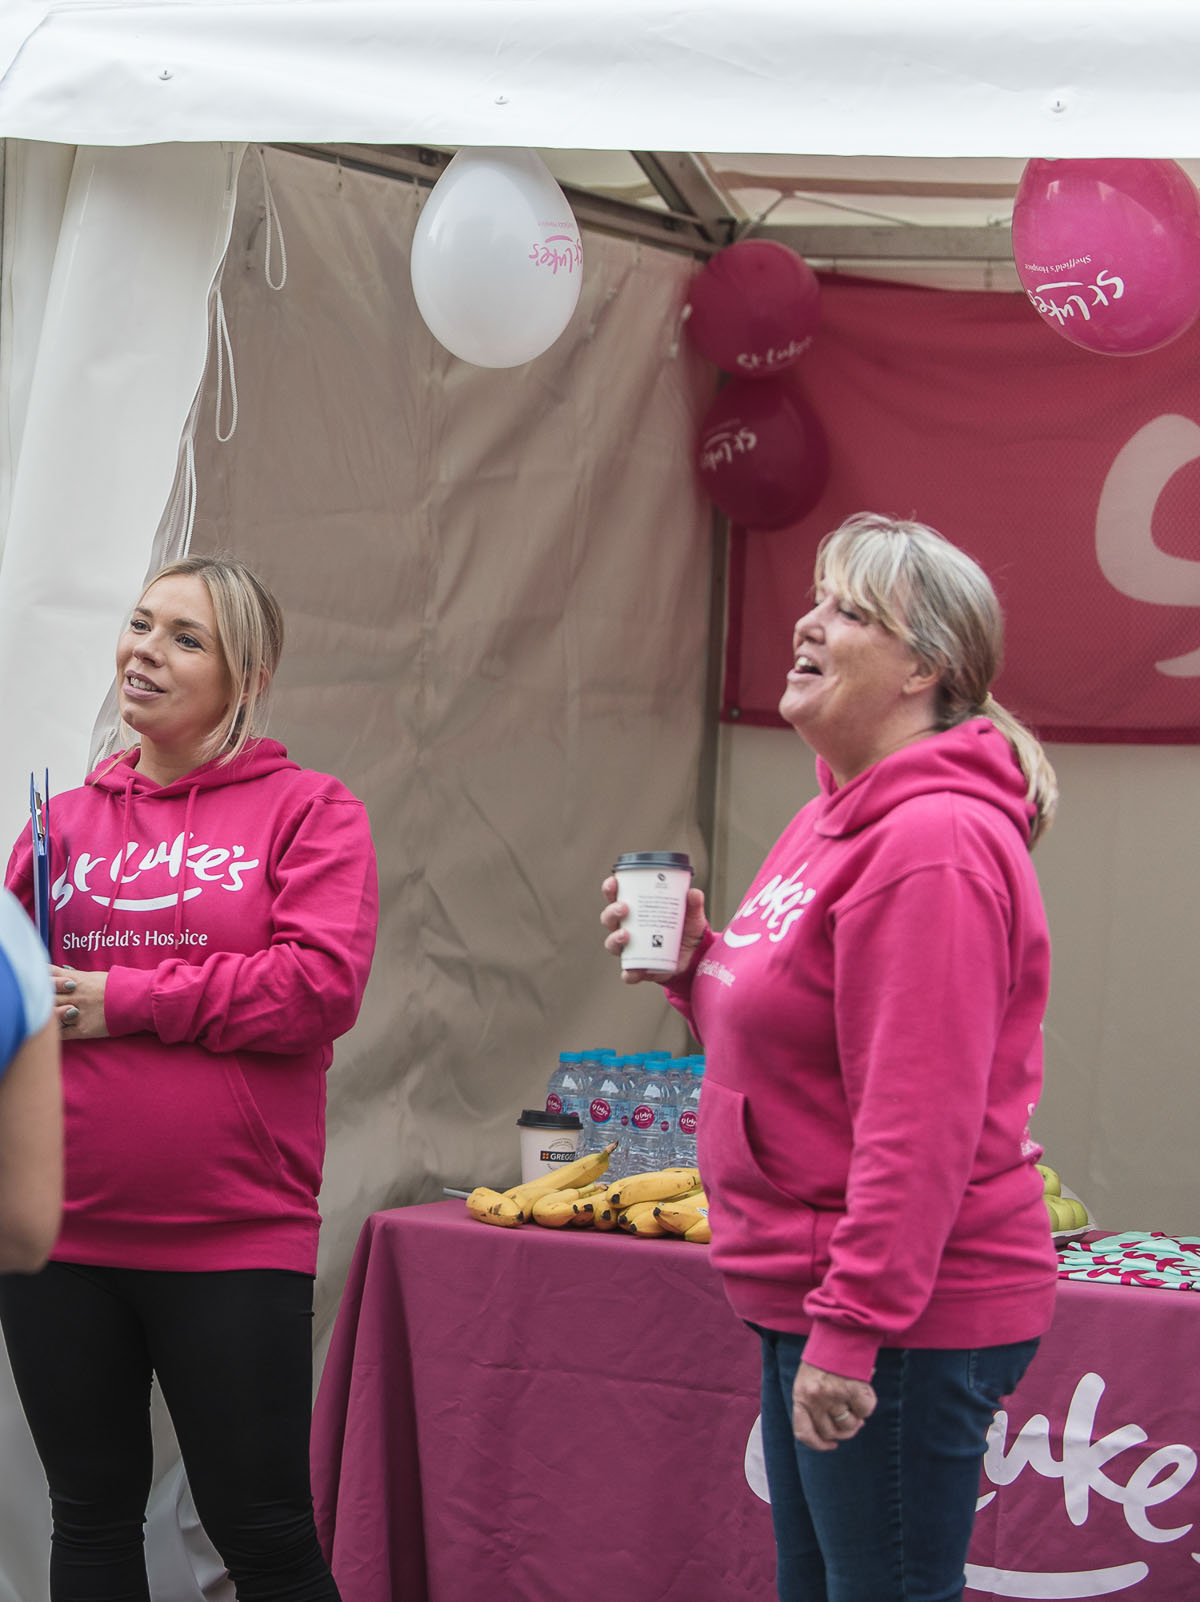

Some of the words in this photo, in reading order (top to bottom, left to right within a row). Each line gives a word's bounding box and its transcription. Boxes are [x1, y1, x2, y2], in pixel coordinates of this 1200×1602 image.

[62, 929, 141, 952] Sheffield's
[550, 1153, 576, 1161] GREG
[975, 1371, 1200, 1565] uke
